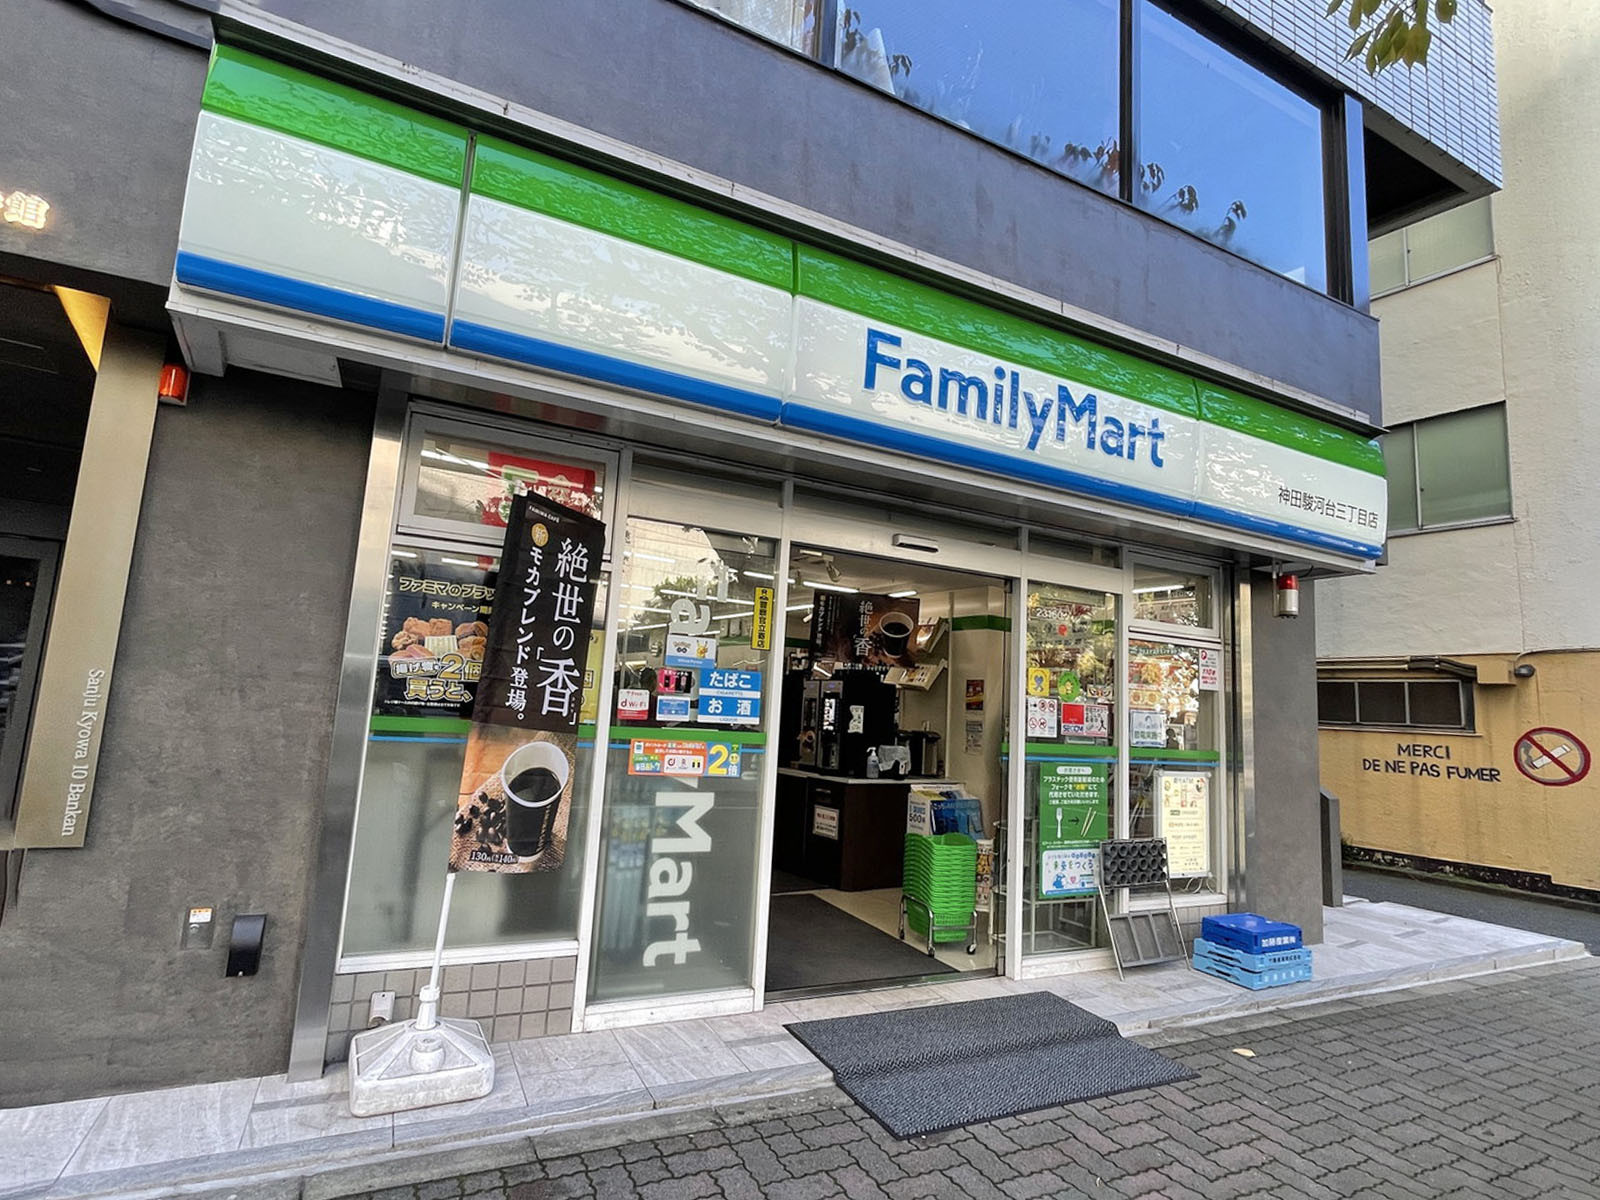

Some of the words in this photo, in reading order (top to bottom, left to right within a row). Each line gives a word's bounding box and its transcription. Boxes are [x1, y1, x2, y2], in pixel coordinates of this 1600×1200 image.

[863, 327, 1165, 468] FamilyMart
[1279, 486, 1379, 529] 神田駿河台三丁目店
[83, 668, 105, 707] Sanju
[709, 671, 752, 688] たばこ
[74, 711, 98, 760] Kyowa
[1397, 743, 1451, 760] MERCI
[71, 764, 89, 779] 10
[1363, 759, 1381, 772] DE
[1385, 760, 1406, 774] NE
[1411, 762, 1441, 777] PAS
[1446, 766, 1501, 782] FUMER
[61, 783, 86, 836] Bankan
